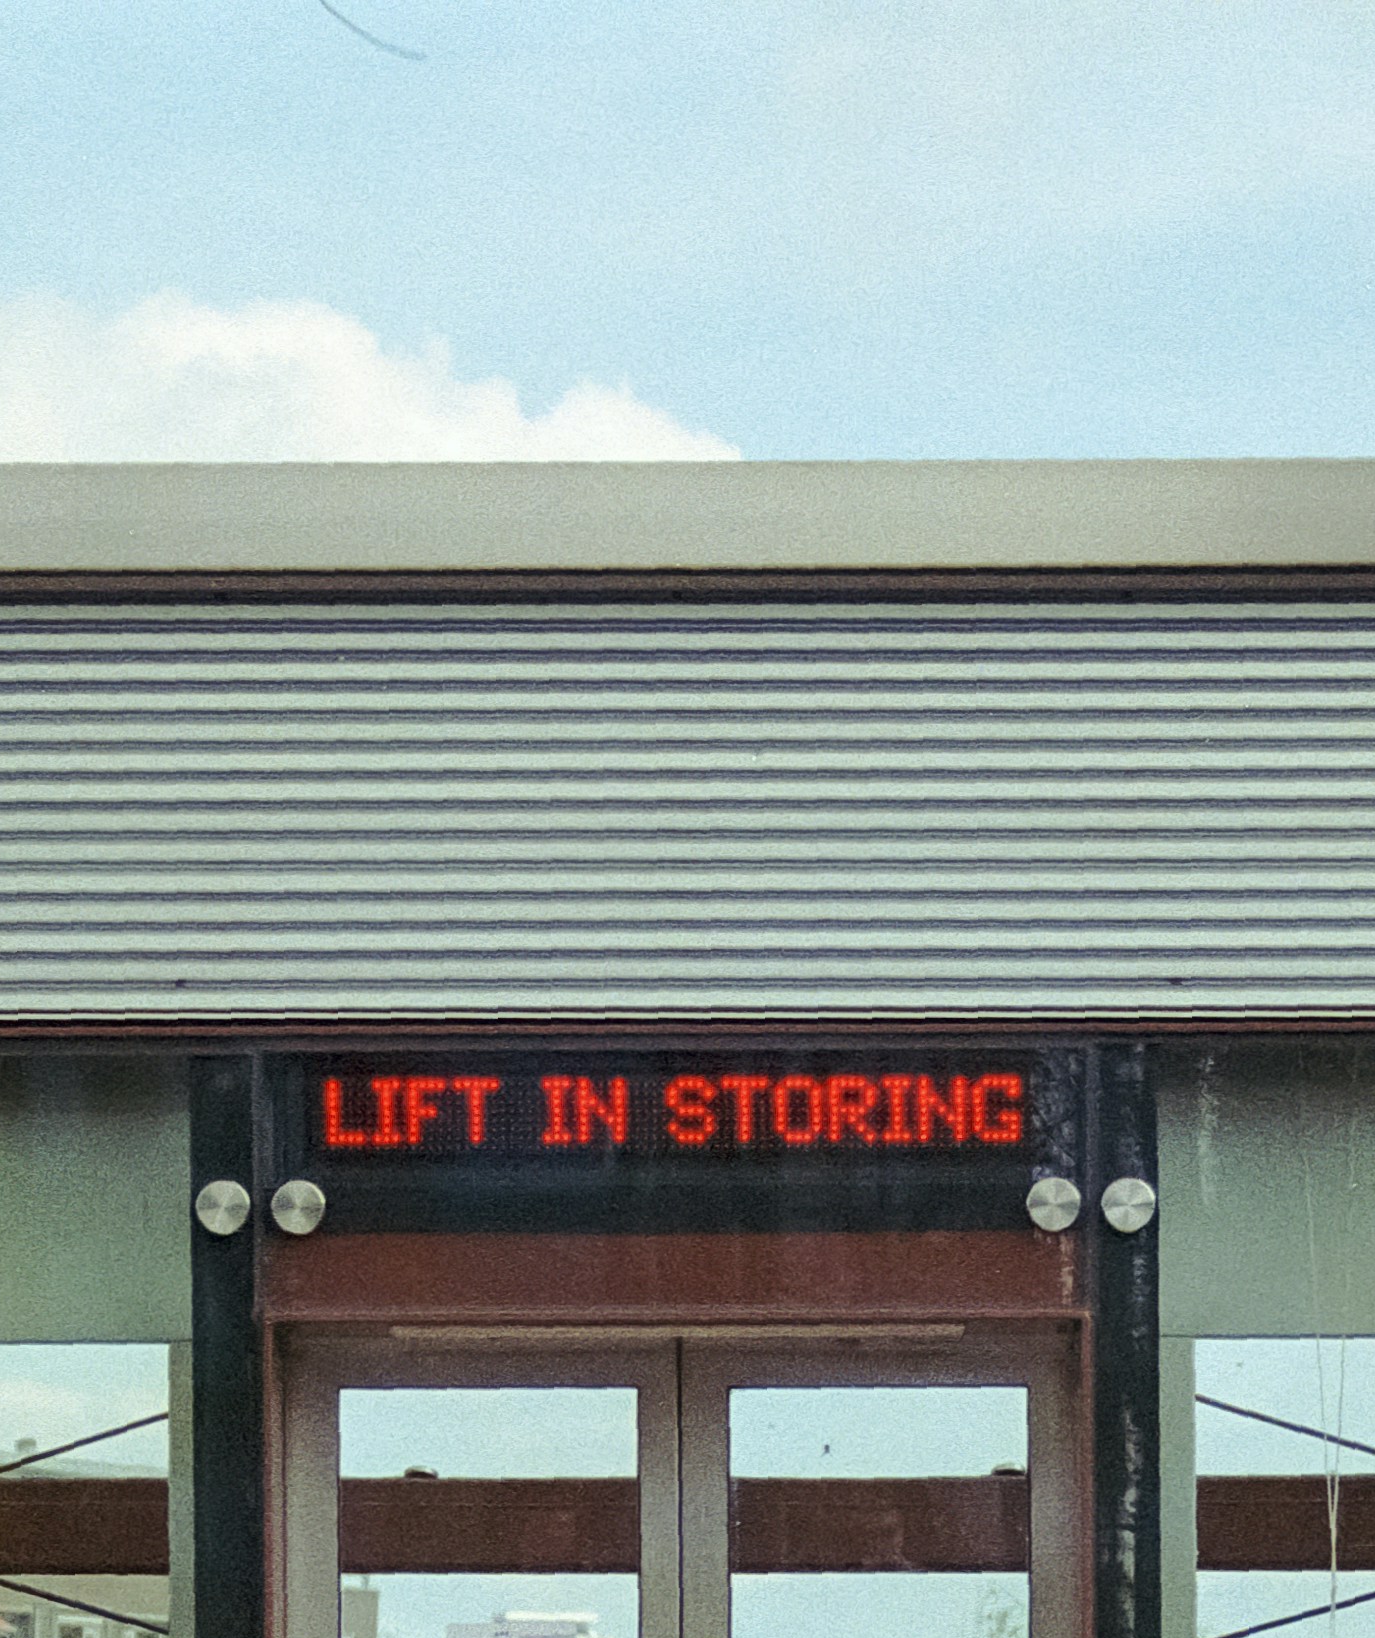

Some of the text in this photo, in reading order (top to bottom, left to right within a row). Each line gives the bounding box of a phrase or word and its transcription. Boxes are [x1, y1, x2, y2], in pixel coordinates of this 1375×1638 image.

[324, 1074, 1022, 1146] LIFT IN STORING
